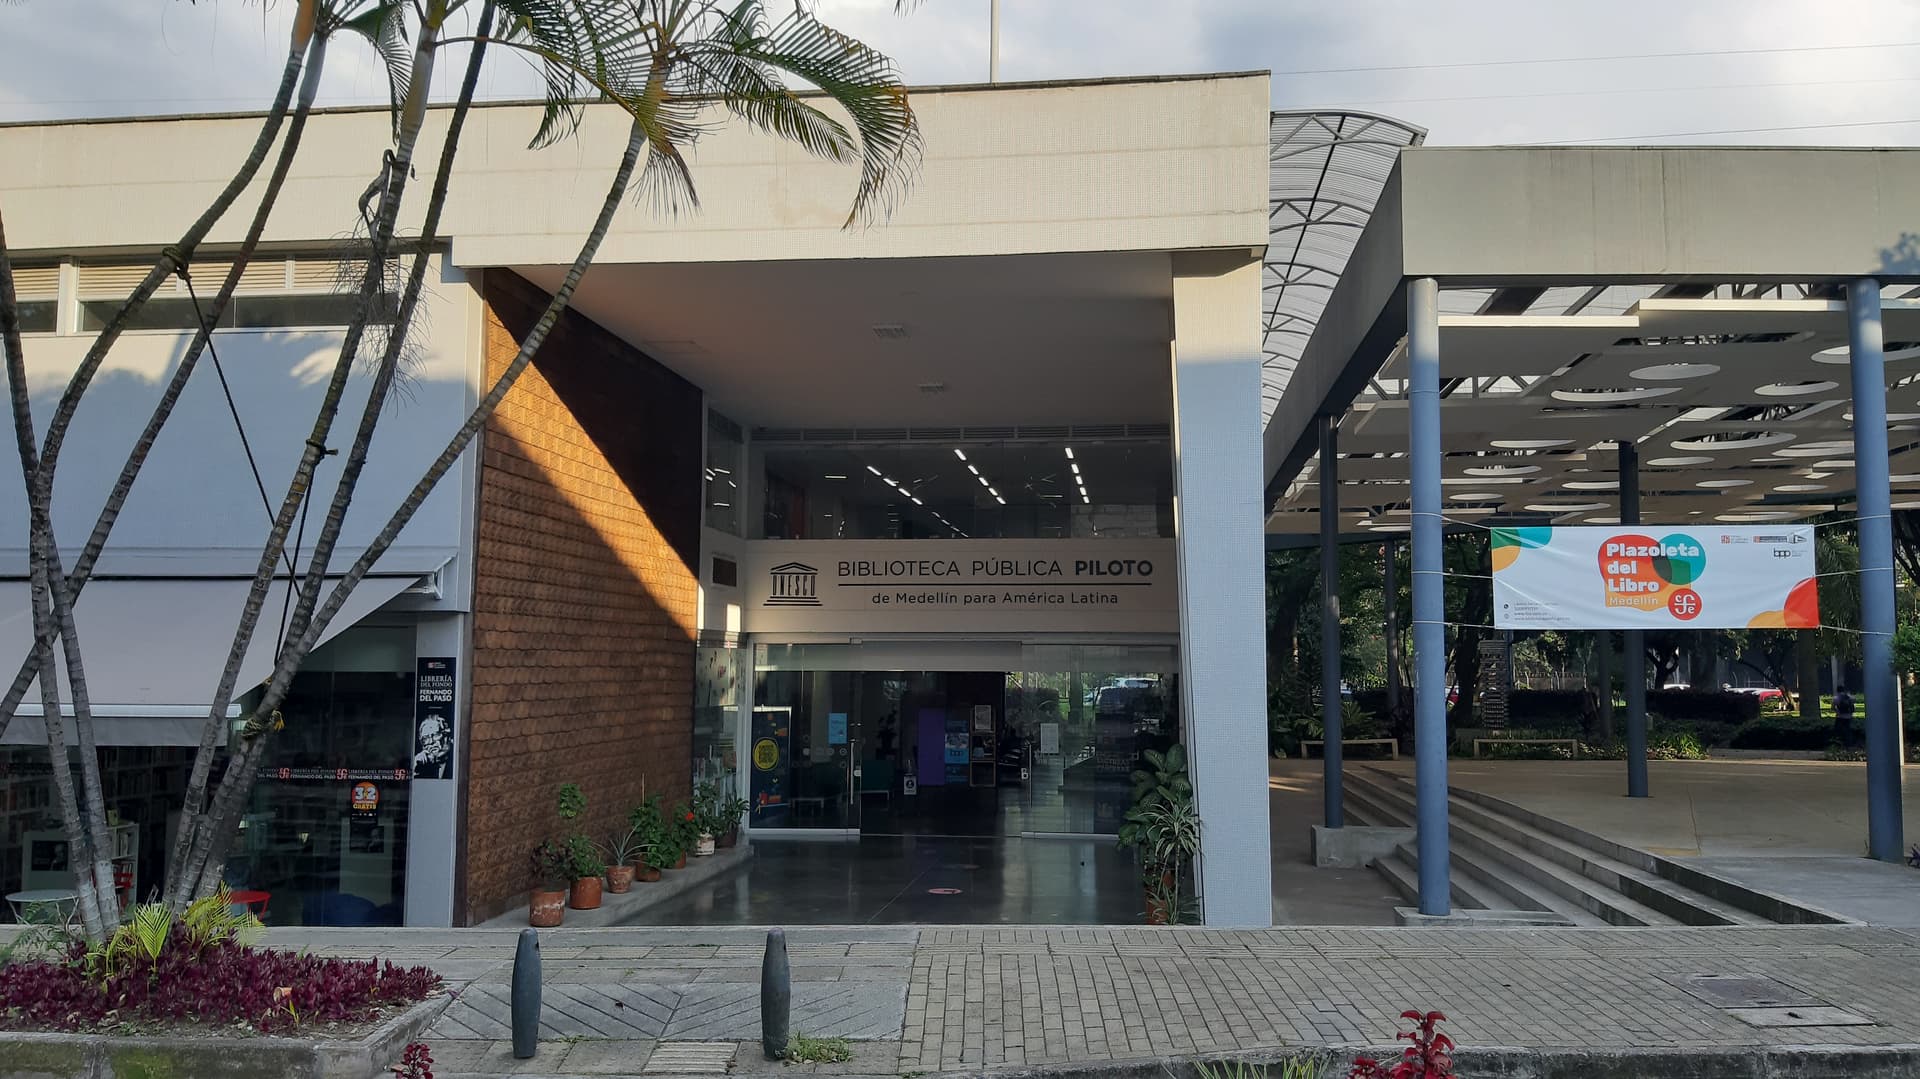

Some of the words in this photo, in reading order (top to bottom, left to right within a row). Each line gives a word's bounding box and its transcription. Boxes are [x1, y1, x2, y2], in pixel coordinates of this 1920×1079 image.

[1606, 543, 1699, 557] Plazoleta
[838, 560, 961, 577] BIBLIOTECA
[972, 557, 1063, 577] PÚBLICA
[1075, 559, 1154, 577] PILOTO
[1607, 560, 1637, 574] del
[772, 575, 816, 596] UNESCO
[1608, 577, 1660, 592] Libro
[872, 592, 890, 604] de
[896, 592, 958, 604] Medellín
[963, 594, 996, 606] para
[1002, 592, 1065, 604] América
[1071, 592, 1118, 604] Latina
[1609, 596, 1659, 606] Medellín
[420, 674, 453, 682] LIBRERÍA
